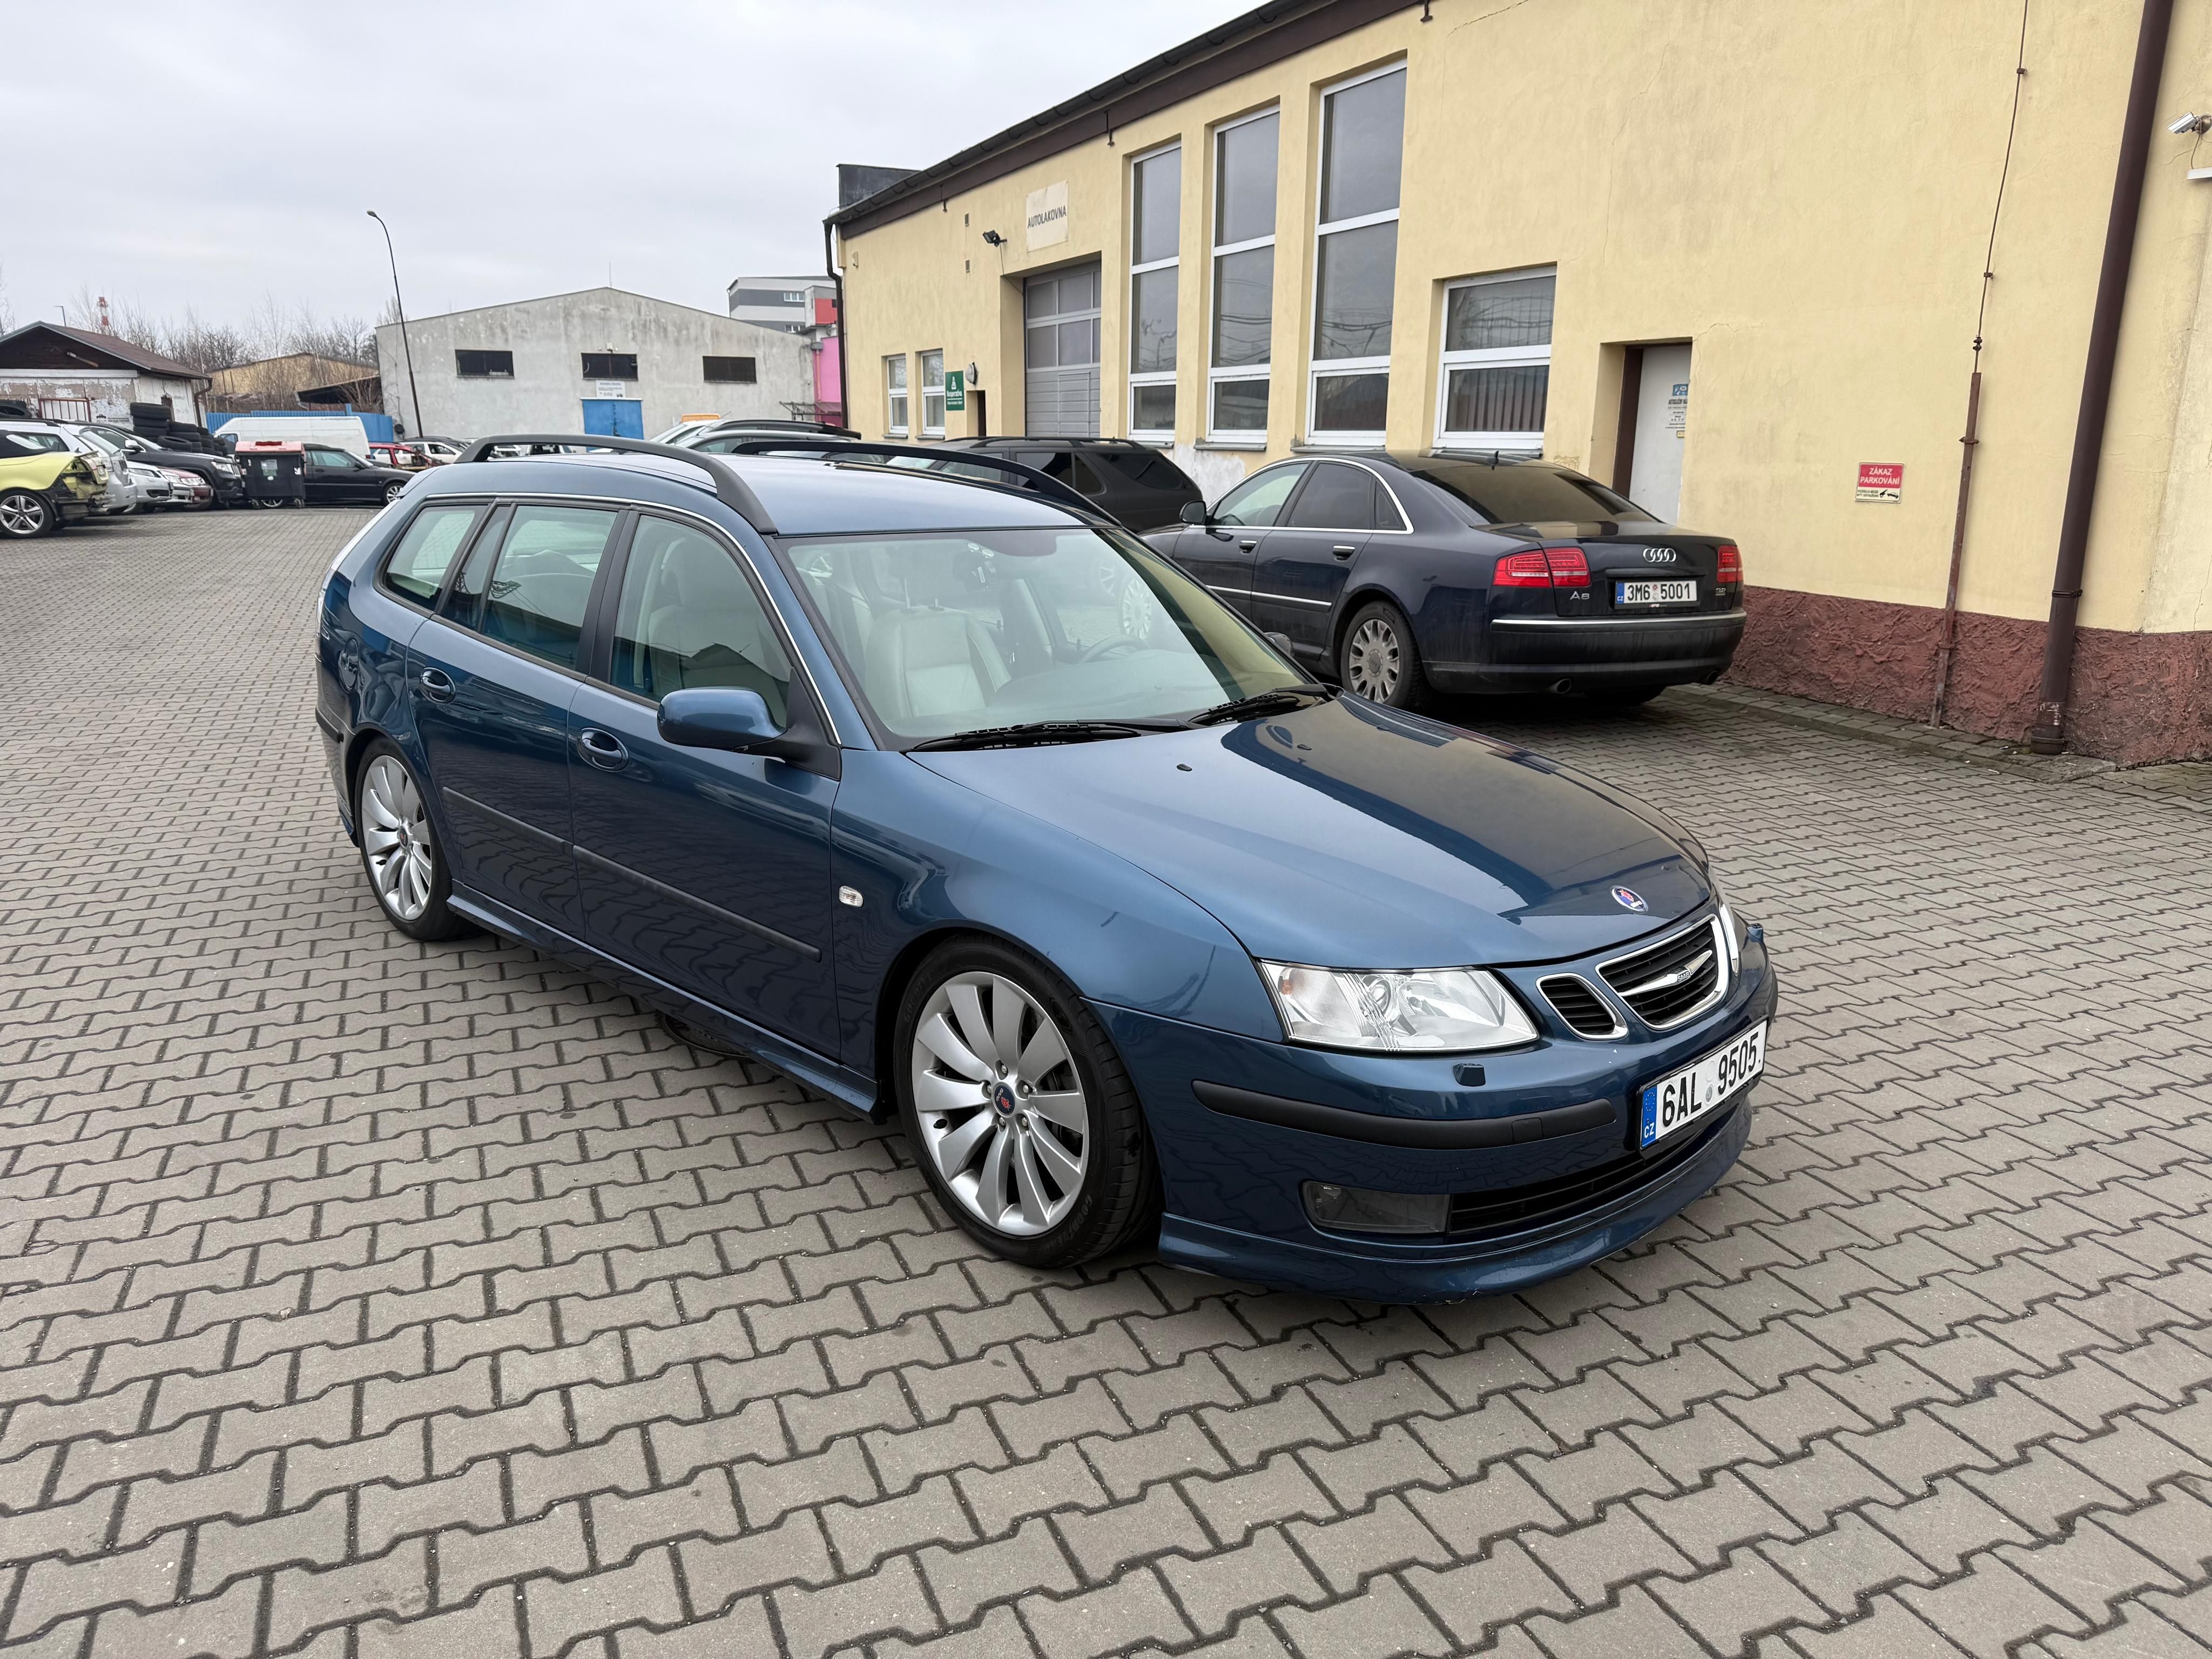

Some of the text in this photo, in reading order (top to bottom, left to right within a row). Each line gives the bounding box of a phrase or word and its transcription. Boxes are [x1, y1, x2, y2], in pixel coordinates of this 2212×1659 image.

[1028, 205, 1067, 229] AUTOLAKOVNA
[1869, 467, 1892, 475] ZÁKAZ
[1860, 476, 1900, 485] PARKOVÁNÍ
[1570, 591, 1589, 600] A8
[1628, 583, 1690, 601] 3M6 5001
[1662, 1031, 1758, 1127] 6AL 9505
[1644, 1122, 1654, 1138] CZ
